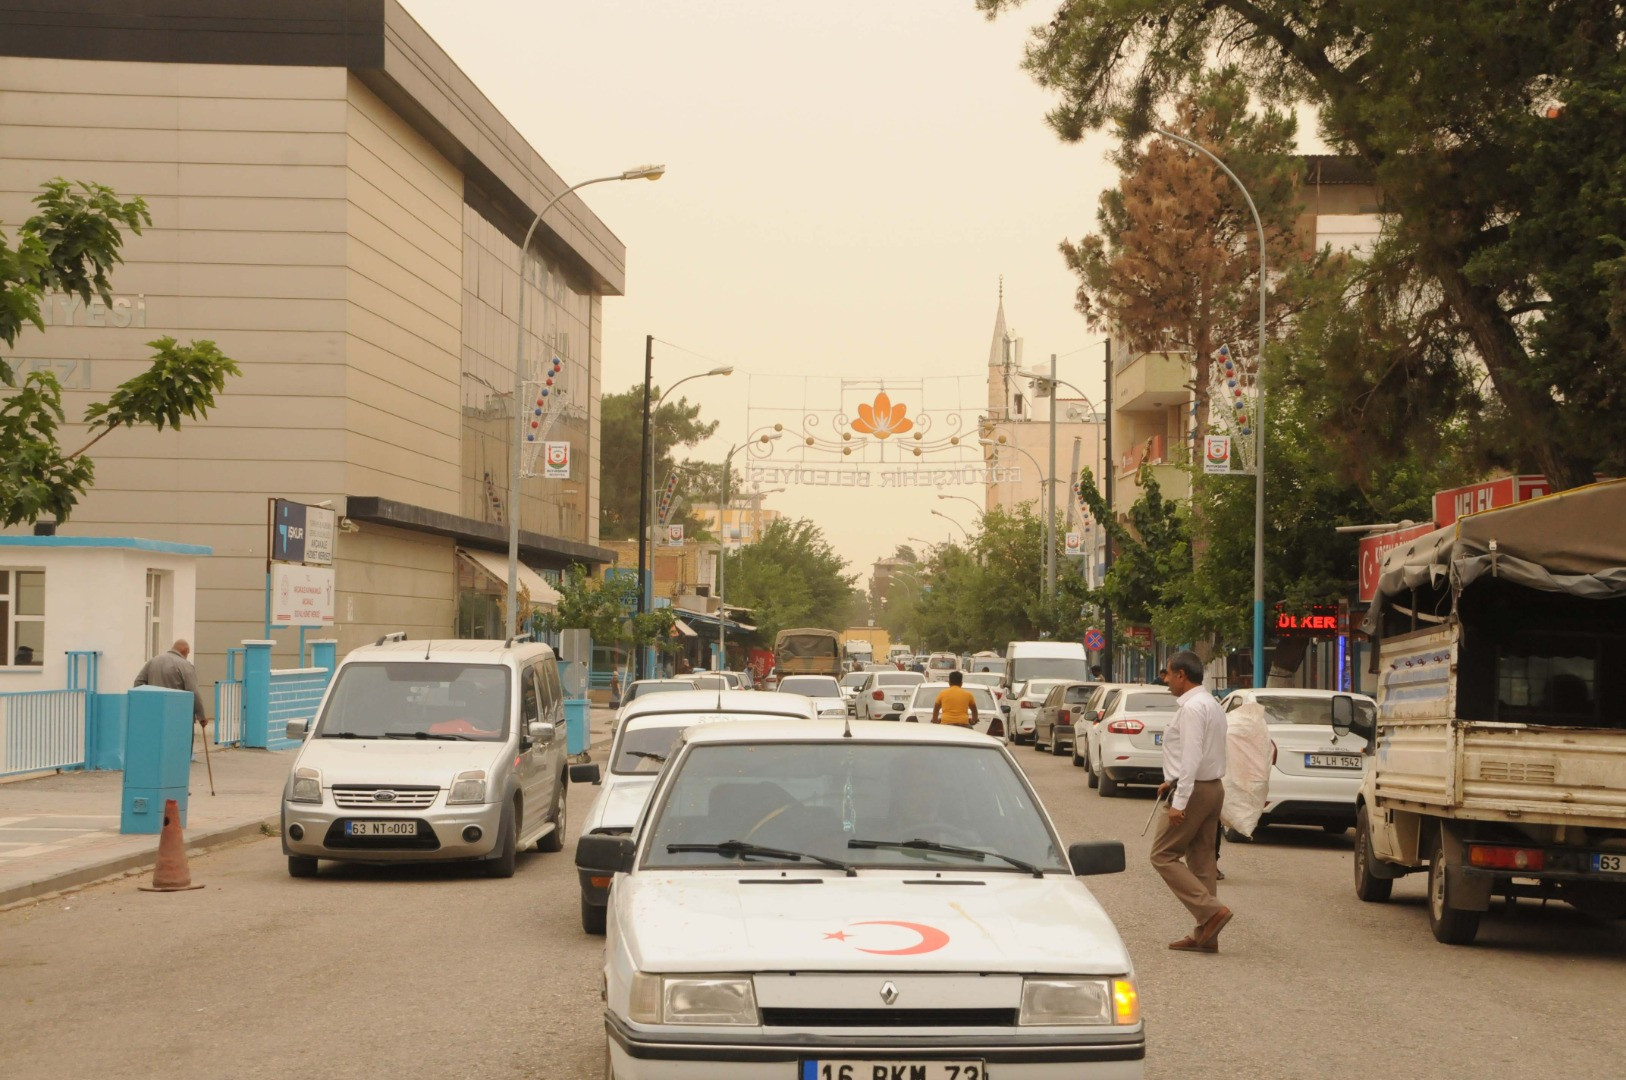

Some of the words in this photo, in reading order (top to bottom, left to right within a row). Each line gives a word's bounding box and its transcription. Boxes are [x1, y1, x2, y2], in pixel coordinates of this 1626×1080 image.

[1279, 613, 1337, 628] ÜLKER
[1311, 756, 1321, 765] 34
[1326, 757, 1337, 766] LH
[1341, 757, 1360, 767] 1542
[352, 823, 366, 834] 63
[373, 823, 387, 834] NT
[394, 823, 414, 834] 003
[1600, 856, 1620, 870] 63
[822, 1064, 854, 1080] 16
